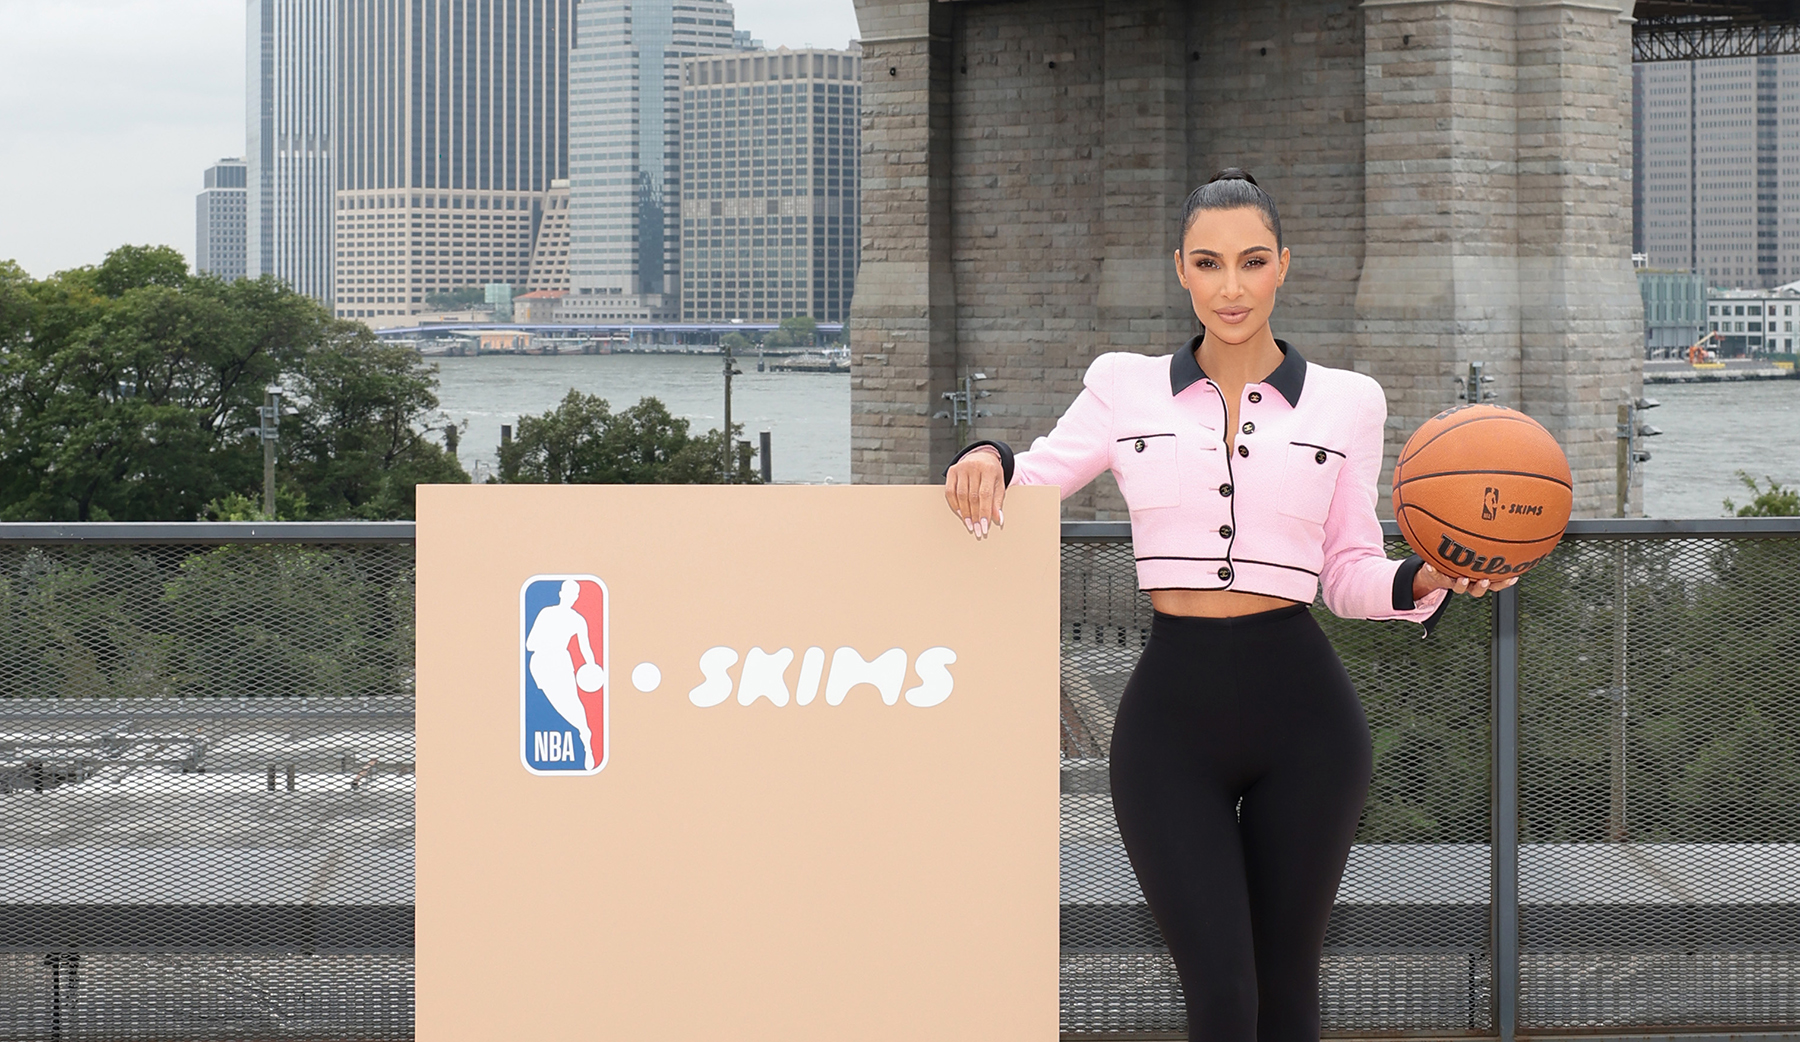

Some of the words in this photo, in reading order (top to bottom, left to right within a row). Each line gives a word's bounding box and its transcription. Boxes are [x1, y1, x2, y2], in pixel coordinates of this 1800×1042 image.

[1508, 503, 1543, 516] SKIMS
[688, 646, 957, 708] SKIMS
[534, 730, 575, 762] NBA
